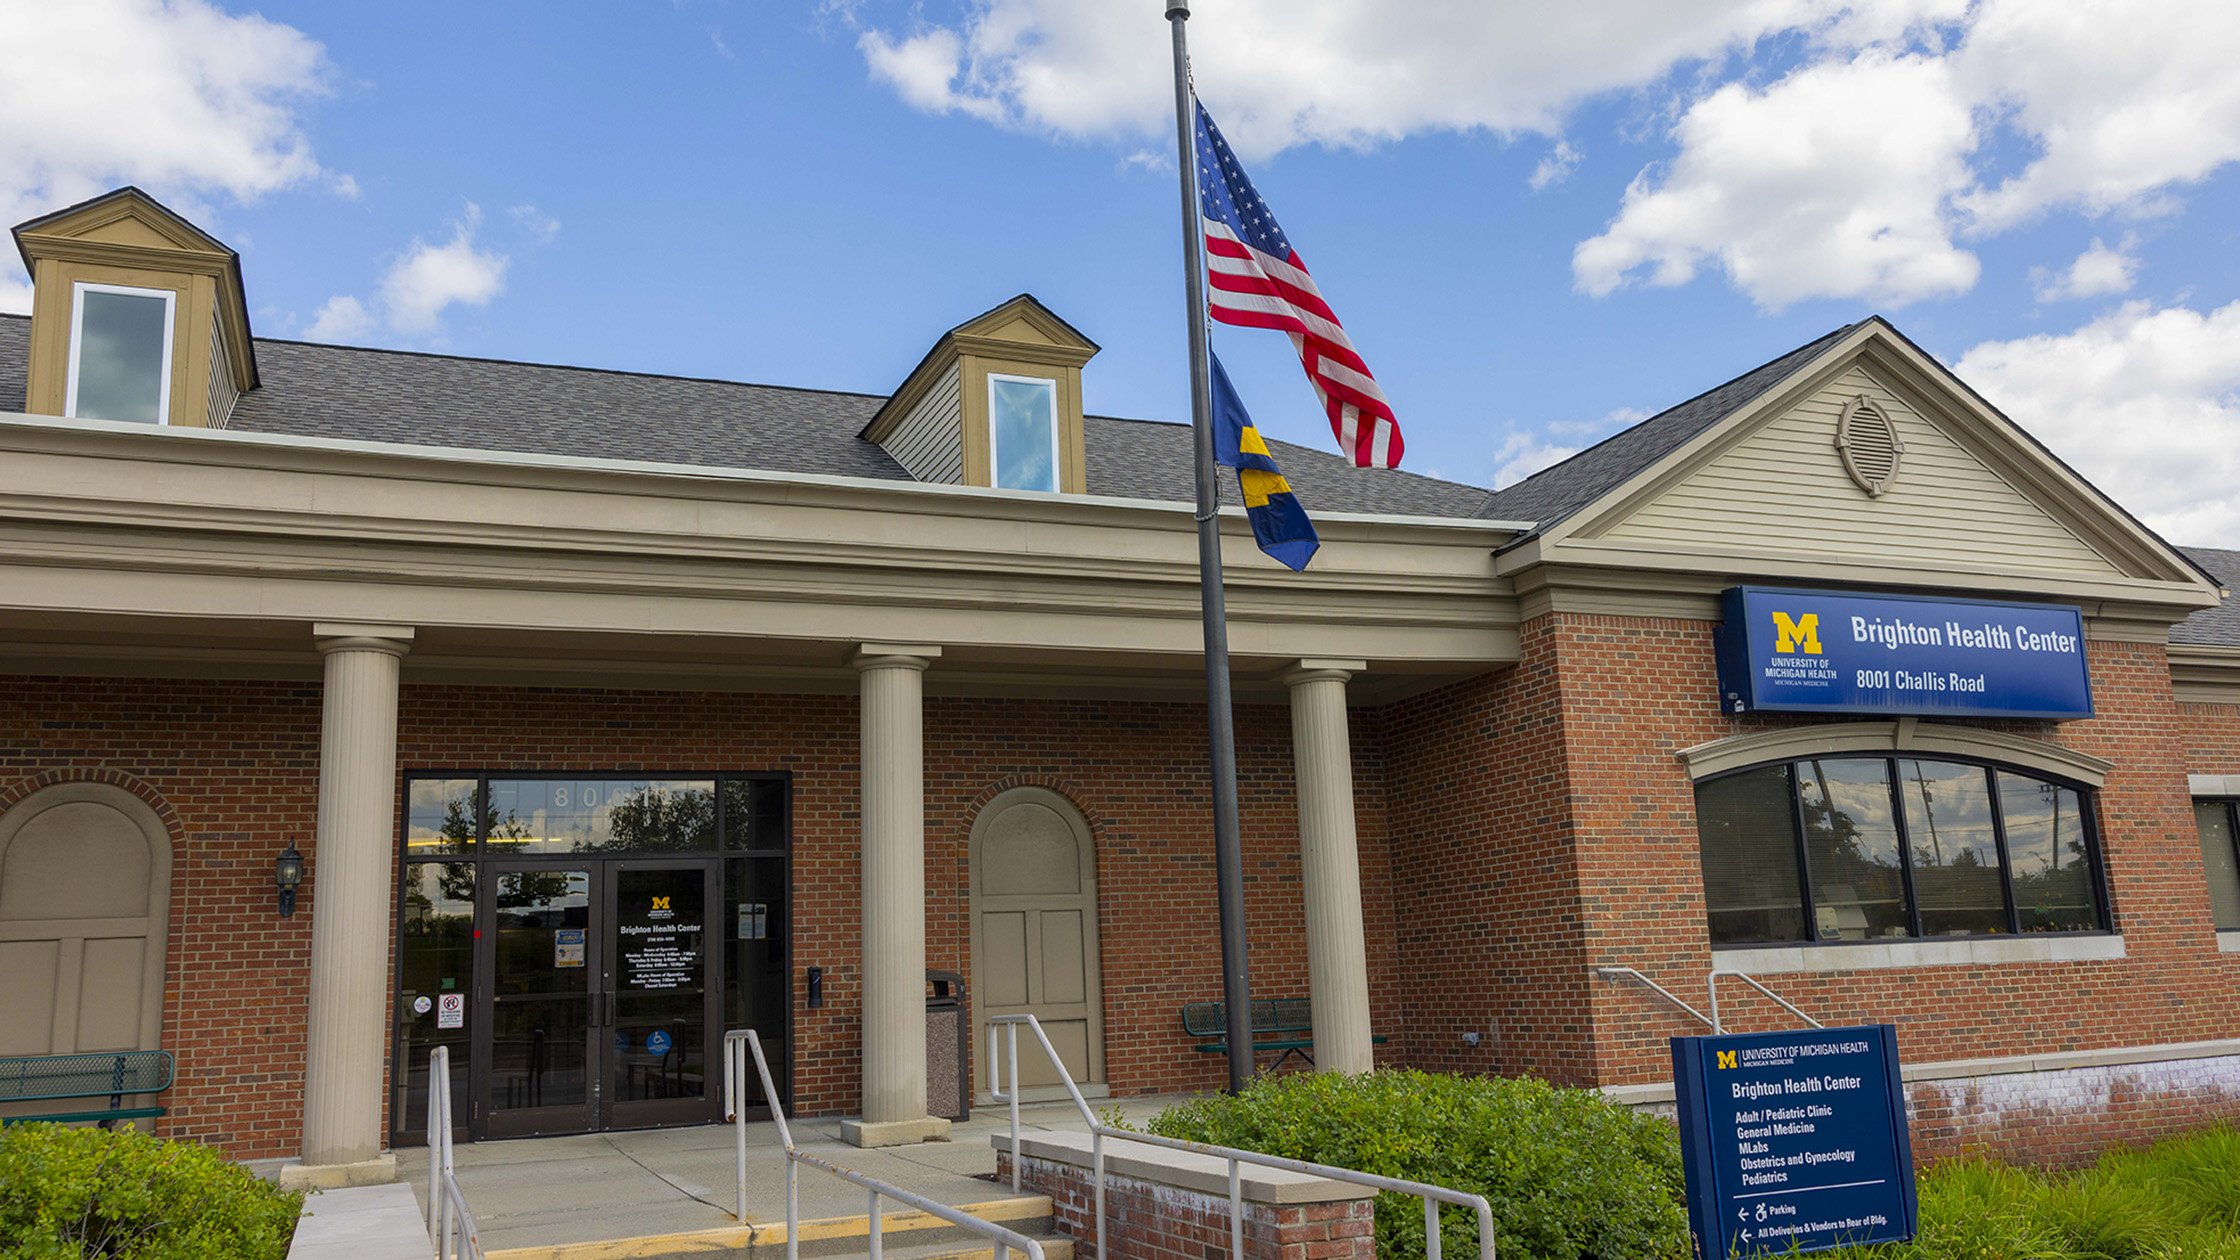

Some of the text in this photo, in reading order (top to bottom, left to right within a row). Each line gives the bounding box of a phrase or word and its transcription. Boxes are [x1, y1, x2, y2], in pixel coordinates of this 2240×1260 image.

[1772, 611, 1822, 654] M
[1851, 616, 2076, 653] Brighton Health Center
[1771, 658, 1829, 668] UNIVERSITY OF
[1765, 668, 1837, 679] MICHIGAN HEALTH
[1856, 670, 1985, 693] 8001 Challis Road
[554, 787, 650, 807] 8001
[652, 897, 670, 909] M
[620, 923, 701, 935] Brighton Health Center
[1717, 1041, 1869, 1069] M UNIVERSITY OF MICHIGAN HEALTH
[1743, 1058, 1794, 1068] MICHIGAN MEDICINE
[1732, 1076, 1861, 1100] Brighton Health Center
[1735, 1111, 1759, 1124] Adult
[1766, 1107, 1805, 1121] Pediatric
[1807, 1105, 1832, 1118] Clinic
[1737, 1122, 1815, 1139] General Medicine
[1739, 1141, 1769, 1155] MLabs
[1741, 1149, 1855, 1170] Obstetrics and Gynecology
[1742, 1172, 1788, 1186] Pediatrics
[1769, 1204, 1796, 1216] Parking
[1758, 1214, 1888, 1239] All Deliveries & Vendors to Rear of Bldg.
